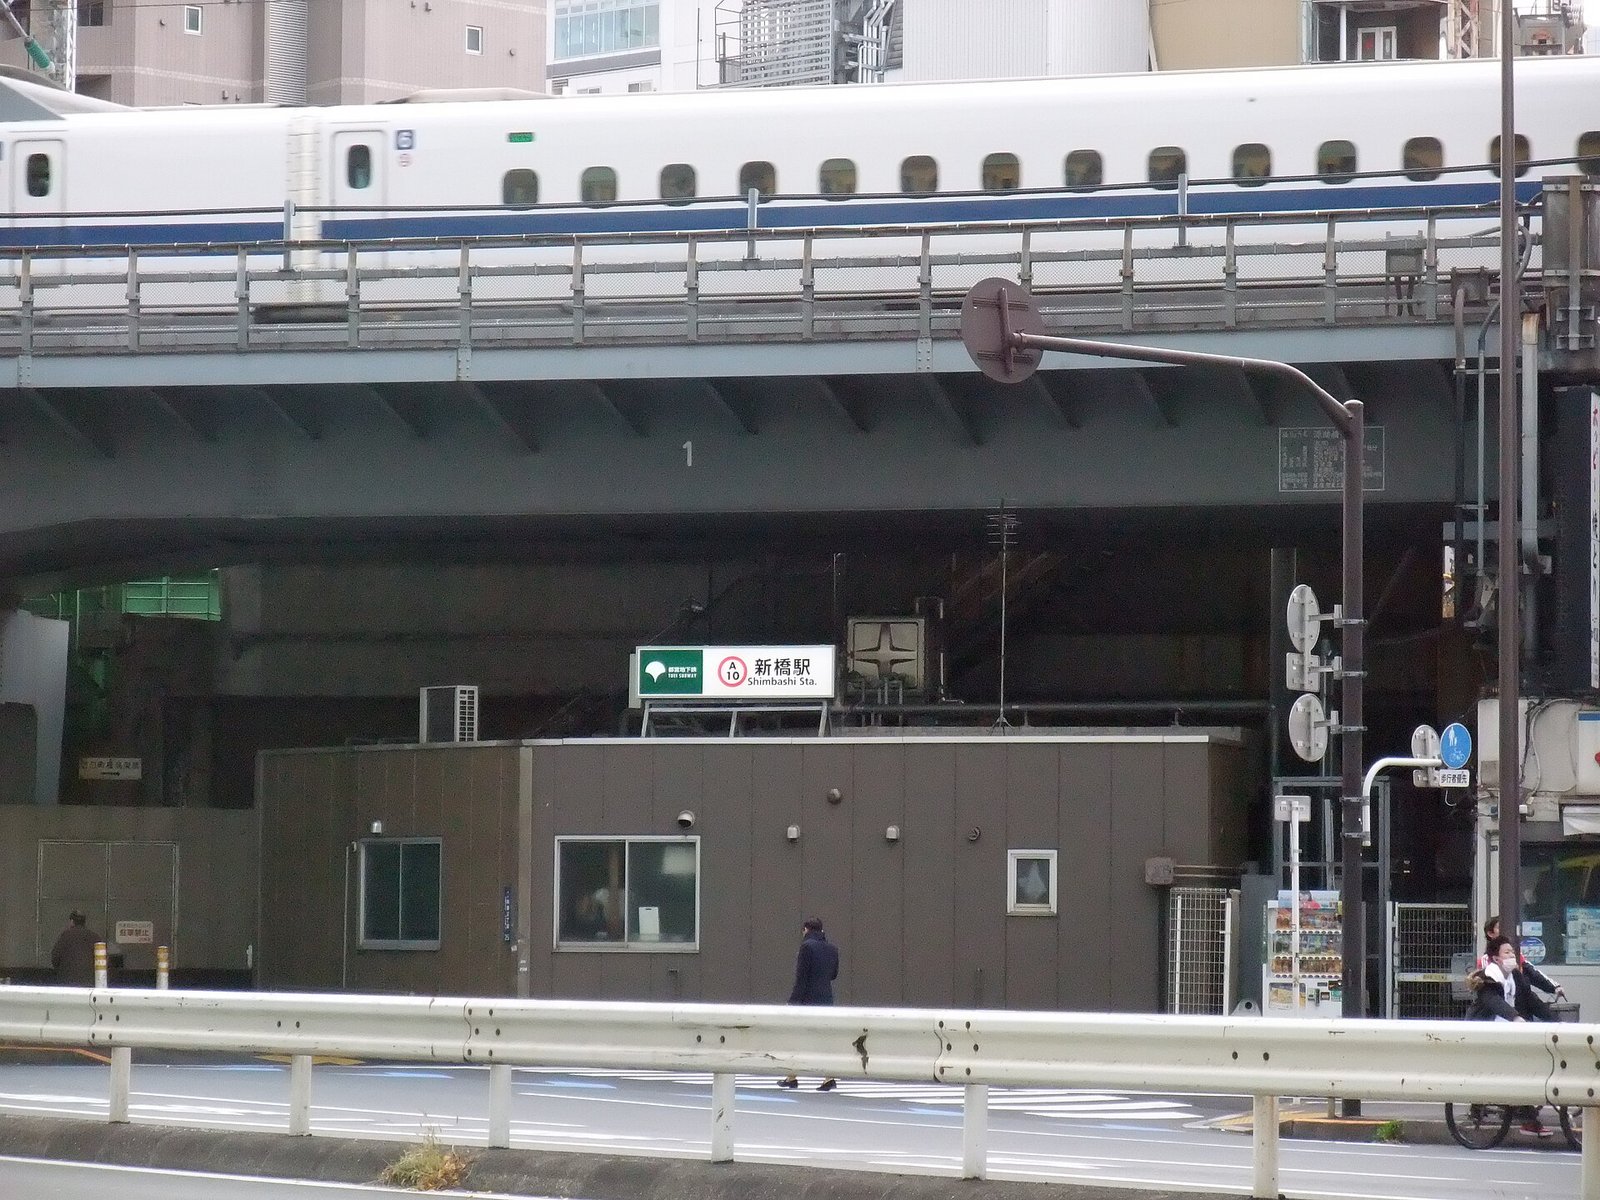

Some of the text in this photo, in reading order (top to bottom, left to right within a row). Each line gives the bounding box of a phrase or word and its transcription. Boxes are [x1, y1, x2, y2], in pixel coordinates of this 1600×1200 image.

[682, 440, 692, 467] 1
[729, 661, 737, 670] A
[754, 658, 811, 676] 新橋駅
[727, 671, 740, 680] 10
[748, 677, 817, 686] Shimbashi Sta.
[1440, 772, 1468, 784] 歩行者優先
